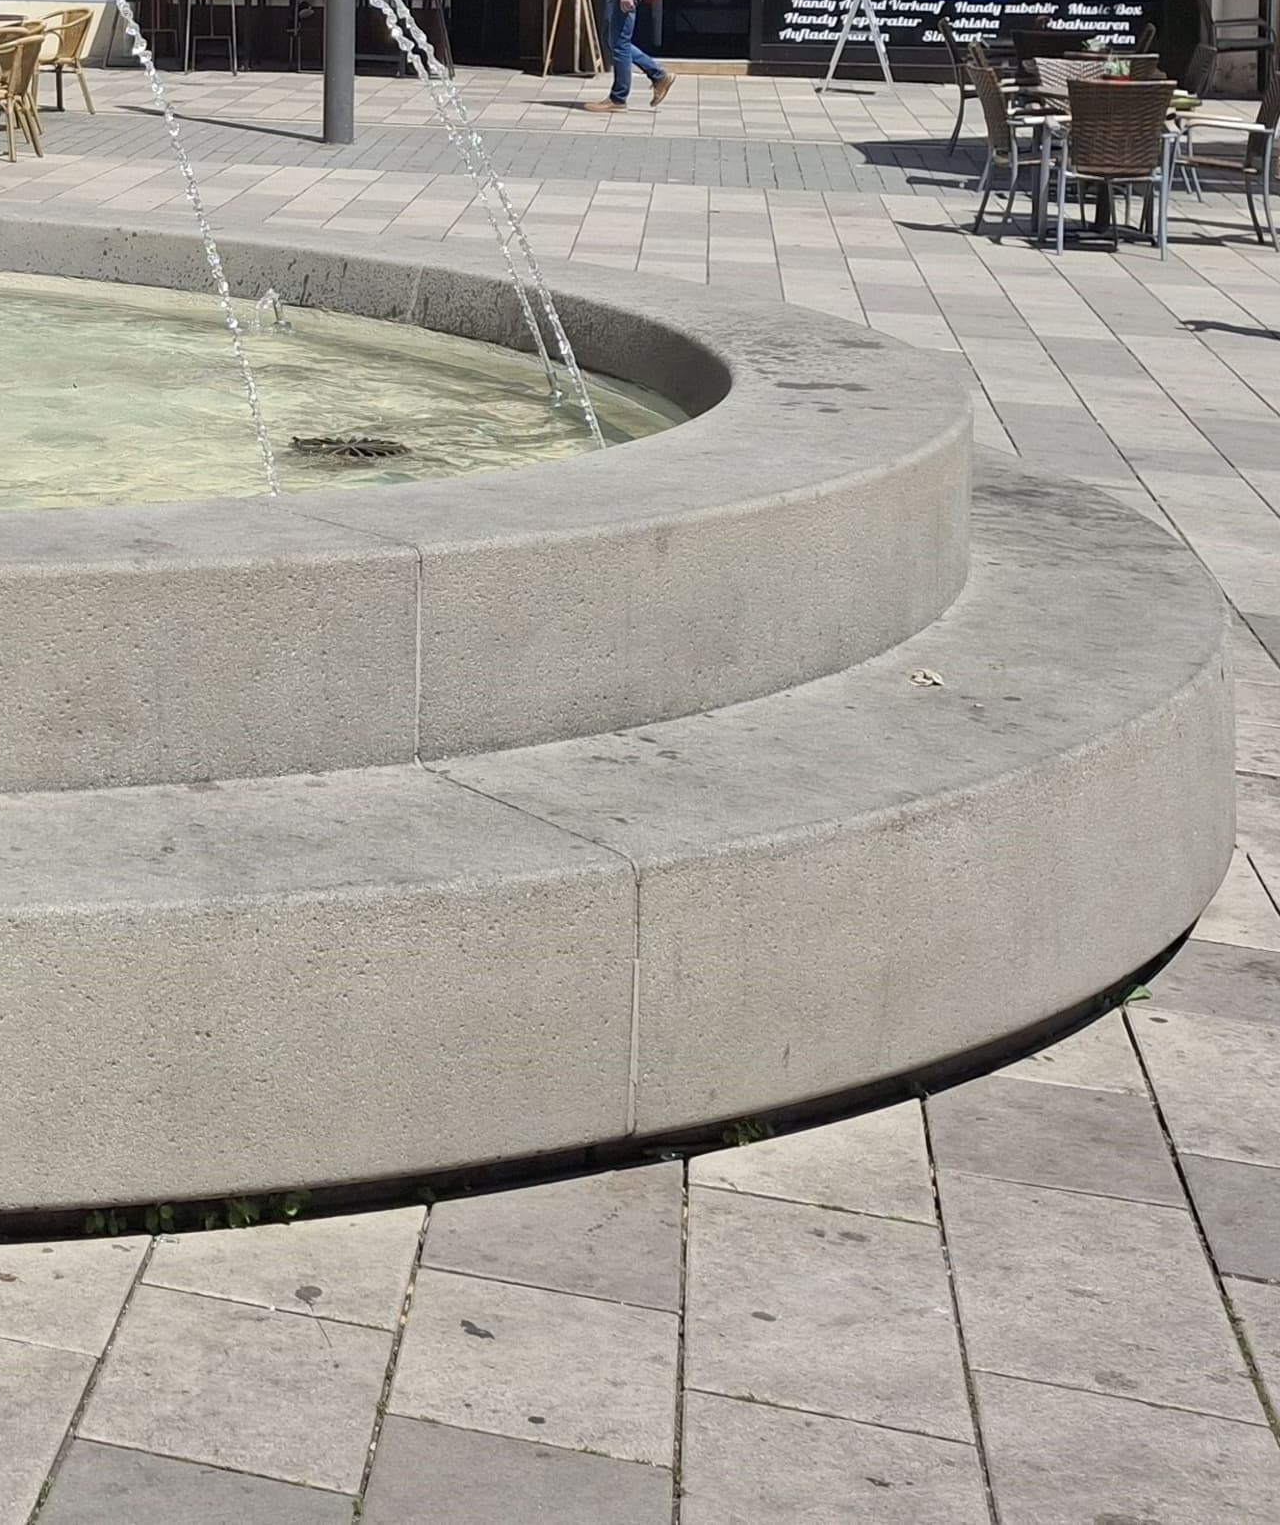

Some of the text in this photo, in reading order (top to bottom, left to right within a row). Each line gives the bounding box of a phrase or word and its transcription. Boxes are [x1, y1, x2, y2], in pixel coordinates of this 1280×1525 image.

[888, 0, 946, 14] Verkauf
[954, 1, 1059, 17] Handy zubehör
[1068, 3, 1143, 16] Music Box
[783, 12, 838, 27] Handy
[944, 17, 1000, 29] -shisha
[1039, 16, 1130, 31] abakwaren
